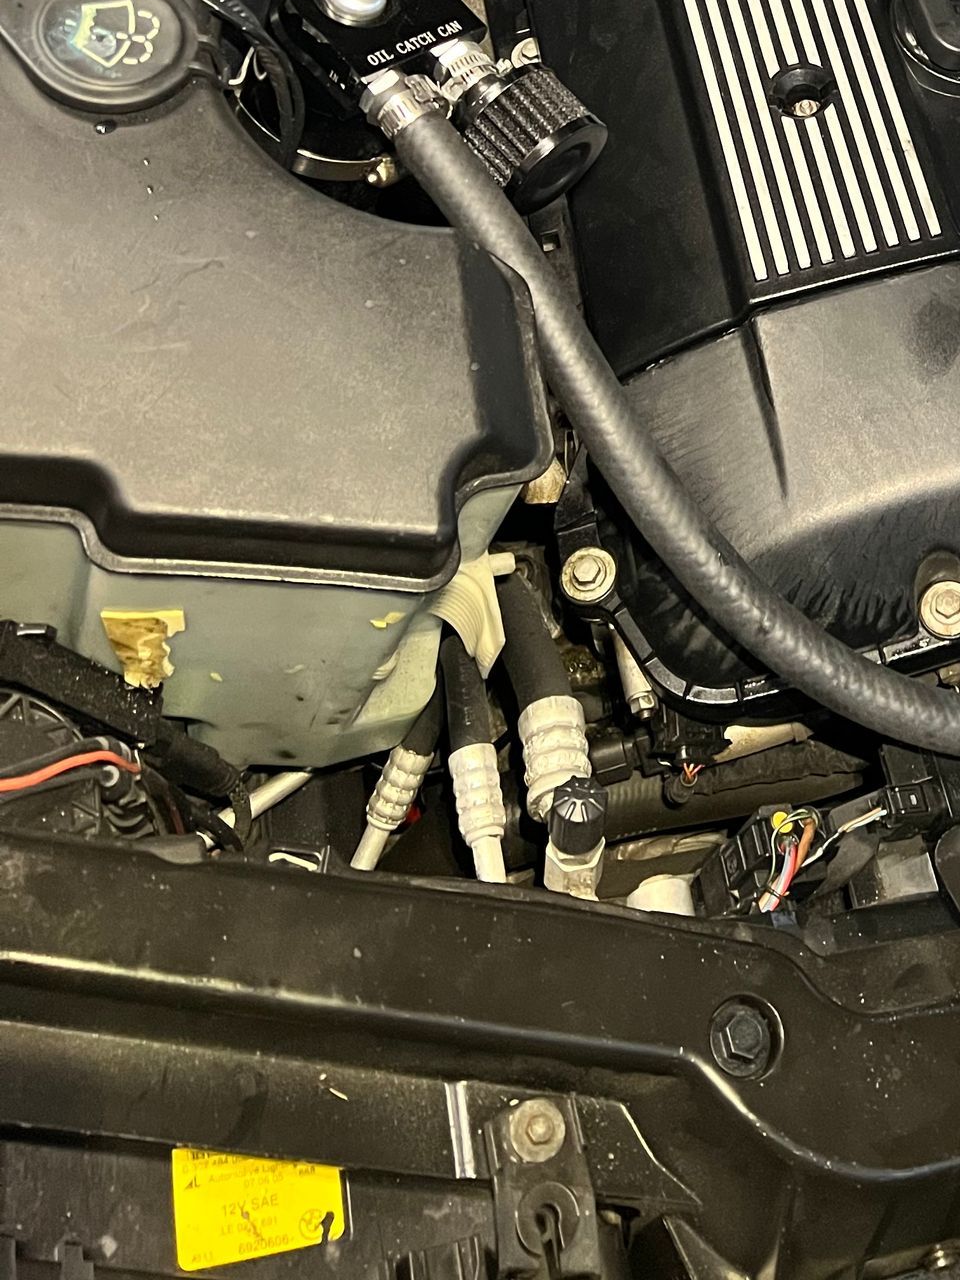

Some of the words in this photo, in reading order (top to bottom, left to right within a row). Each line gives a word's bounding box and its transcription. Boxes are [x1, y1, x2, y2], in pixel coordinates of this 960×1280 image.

[367, 49, 395, 66] OIL
[395, 31, 437, 54] CATCH
[437, 20, 463, 38] CAN
[251, 1194, 279, 1211] SAE
